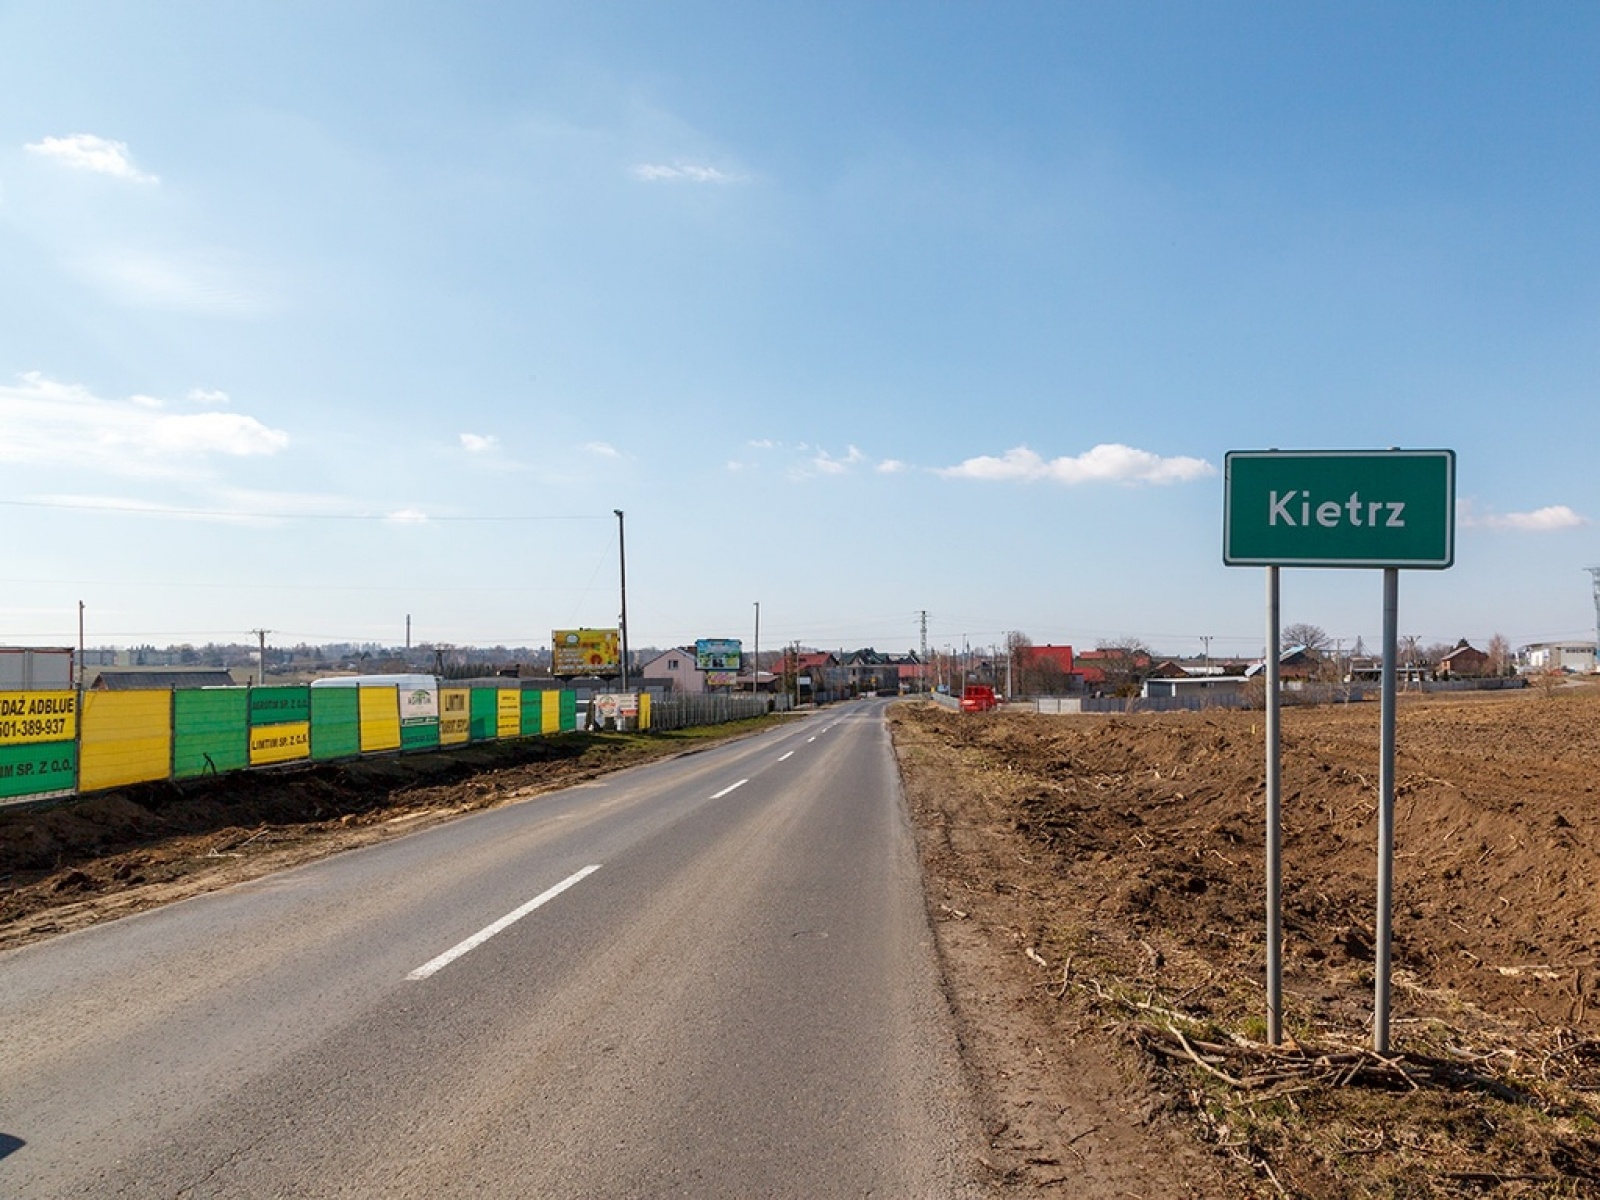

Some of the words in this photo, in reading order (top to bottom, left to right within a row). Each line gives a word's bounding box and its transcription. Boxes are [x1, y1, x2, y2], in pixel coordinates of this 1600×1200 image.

[1269, 490, 1406, 527] Kietrz
[0, 696, 26, 716] DAŻ
[28, 698, 74, 715] ADBLUE
[39, 761, 48, 774] Z
